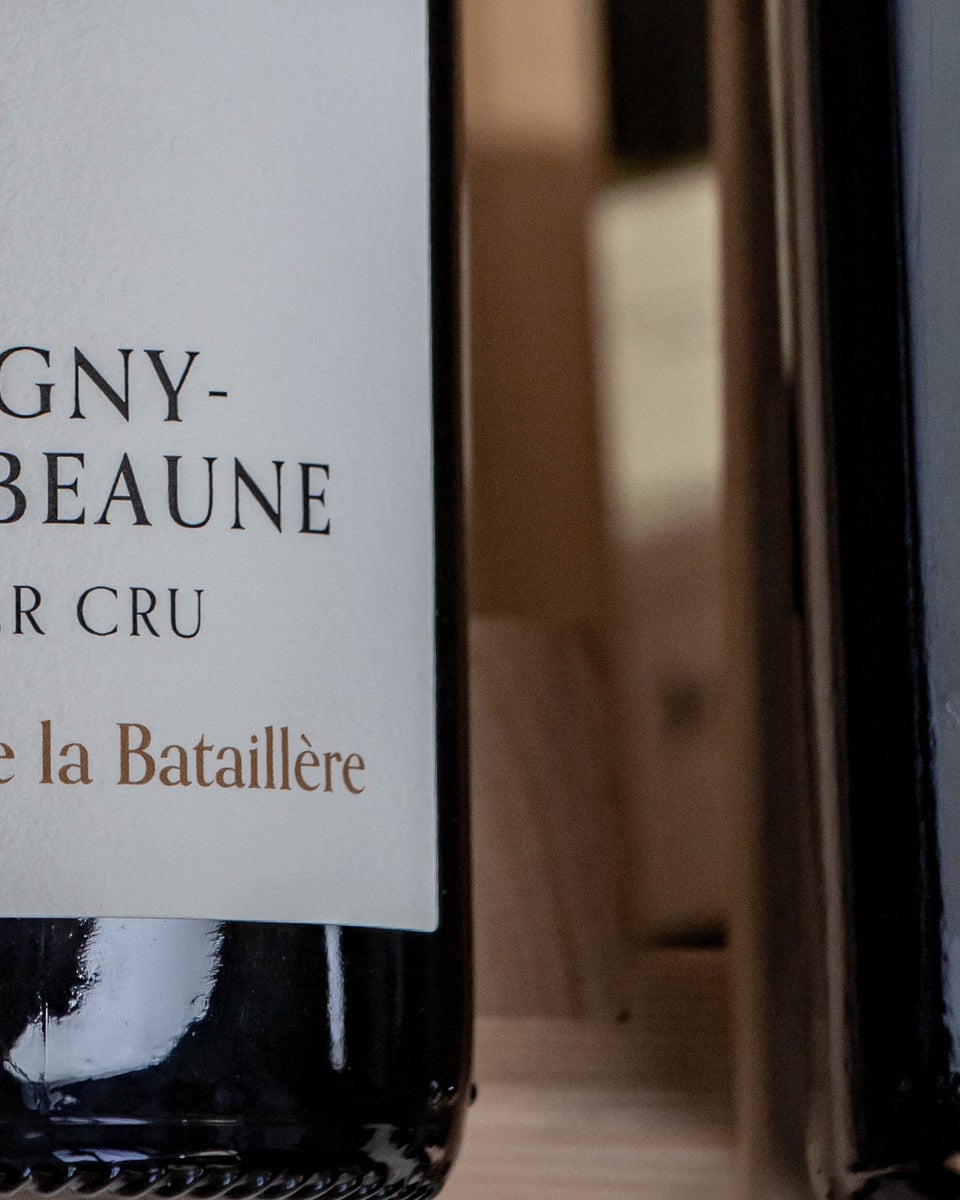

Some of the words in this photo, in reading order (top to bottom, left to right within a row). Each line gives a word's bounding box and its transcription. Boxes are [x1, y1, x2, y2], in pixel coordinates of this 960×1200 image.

[76, 585, 205, 640] CRU
[38, 719, 94, 786] la
[115, 722, 366, 795] Bataillère
